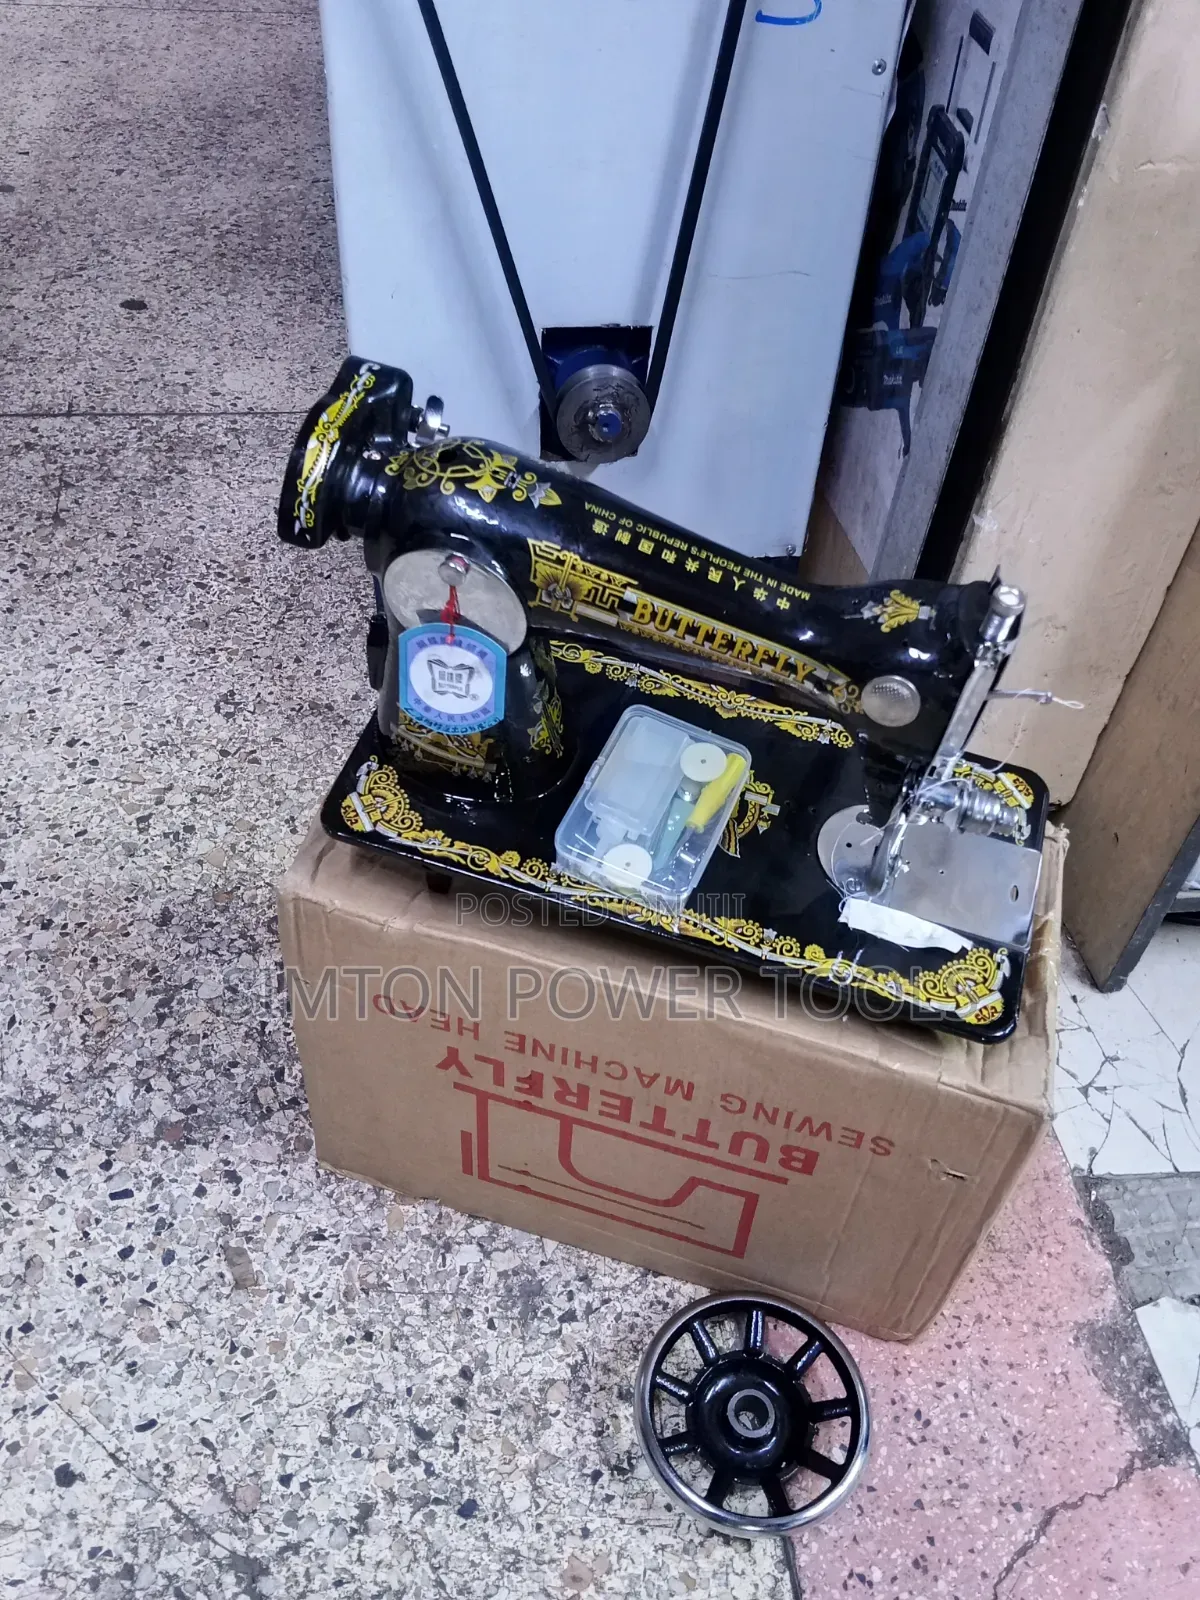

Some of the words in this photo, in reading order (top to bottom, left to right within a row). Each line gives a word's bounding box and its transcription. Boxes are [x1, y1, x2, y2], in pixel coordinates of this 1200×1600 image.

[584, 501, 616, 521] CHINA
[619, 518, 633, 528] OF
[636, 523, 688, 551] REPUBLIC
[592, 518, 791, 610] 中华人民共和国制造
[690, 546, 741, 573] PEOPLE'S
[743, 568, 763, 583] THE
[766, 577, 778, 588] IN
[780, 582, 811, 601] MADE
[632, 598, 818, 684] BUTTERFLY
[372, 994, 480, 1041] HEAD
[504, 1031, 695, 1101] MACHINE
[435, 1046, 820, 1176] BUTTERFLY
[720, 1093, 895, 1157] SEWING
